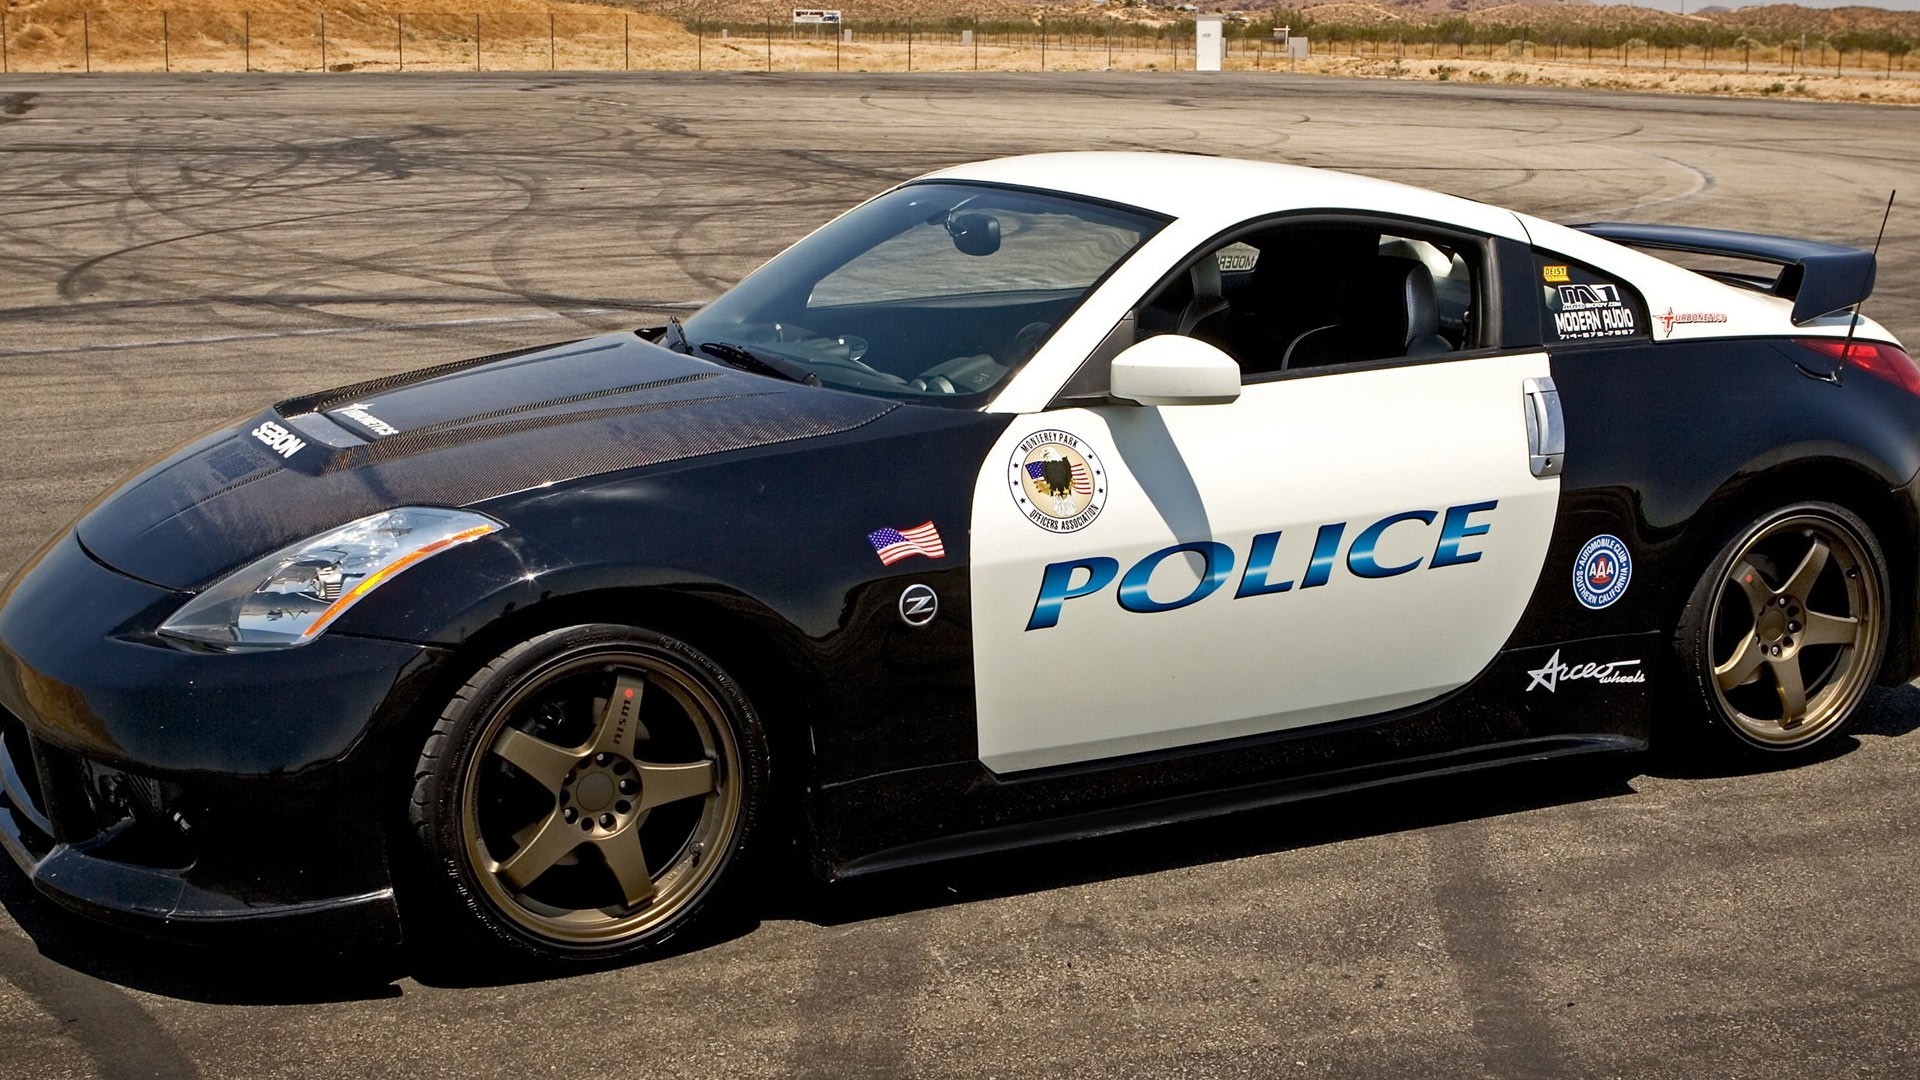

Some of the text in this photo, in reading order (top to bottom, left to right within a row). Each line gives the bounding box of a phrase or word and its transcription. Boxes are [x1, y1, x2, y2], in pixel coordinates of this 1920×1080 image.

[1545, 267, 1565, 275] DEIST
[1554, 307, 1634, 335] MODERN AUDIO
[252, 421, 306, 459] SEBON
[1021, 432, 1078, 453] MONTEREY PARK
[1029, 503, 1099, 531] OFFICERS ASSOCIATION
[1025, 500, 1499, 632] POLICE
[1579, 538, 1628, 566] AUTOMOBILE CLUB
[1589, 560, 1614, 579] AAA
[1576, 567, 1629, 604] SOUTHERN CALIFORNIA
[1599, 669, 1646, 684] wheels
